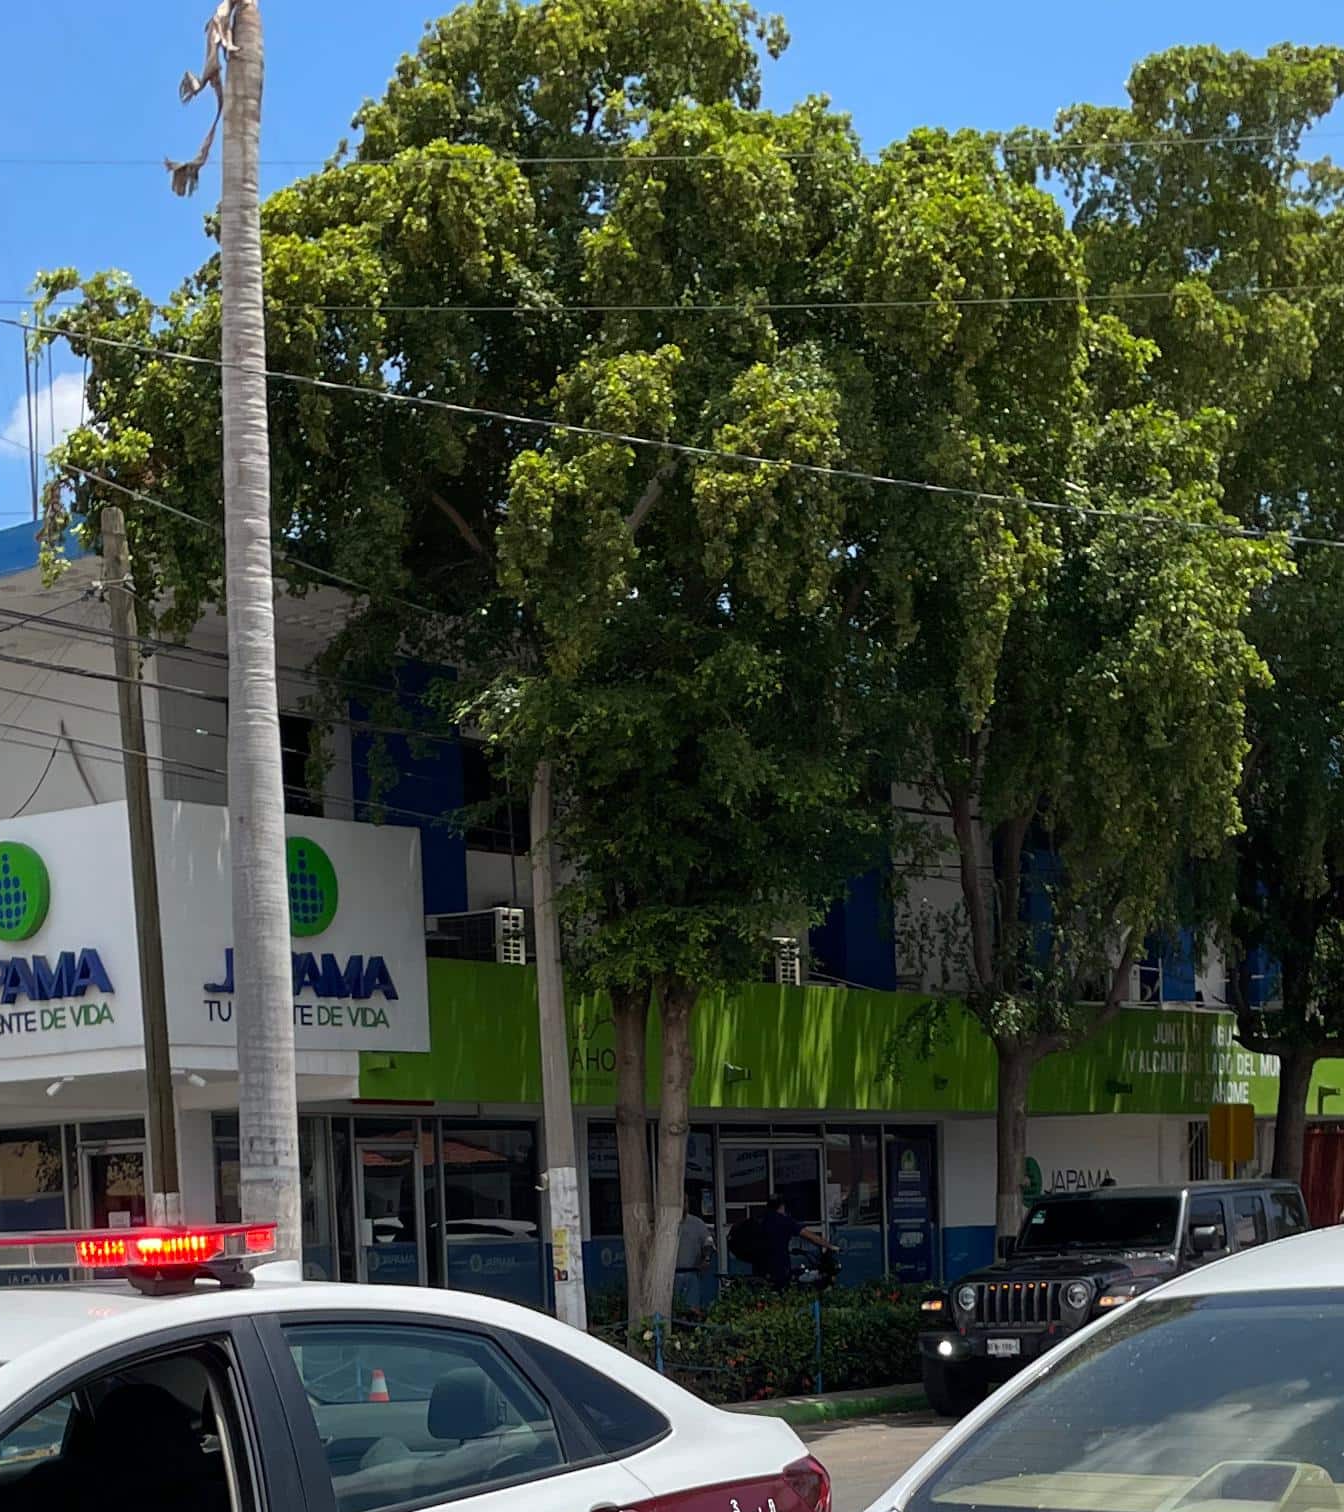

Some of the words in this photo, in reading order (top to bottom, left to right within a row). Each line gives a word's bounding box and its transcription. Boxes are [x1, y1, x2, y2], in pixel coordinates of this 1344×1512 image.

[204, 947, 399, 1001] JAMA
[40, 1007, 66, 1031] DE
[70, 1001, 115, 1027] VIDA
[204, 1000, 232, 1021] TU
[317, 1006, 343, 1027] DE
[347, 1006, 390, 1028] VIDA
[571, 1047, 617, 1072] AHO
[1138, 1050, 1233, 1075] ALCANTARLADO
[1237, 1054, 1256, 1076] DEL
[1211, 1081, 1249, 1104] AHOME
